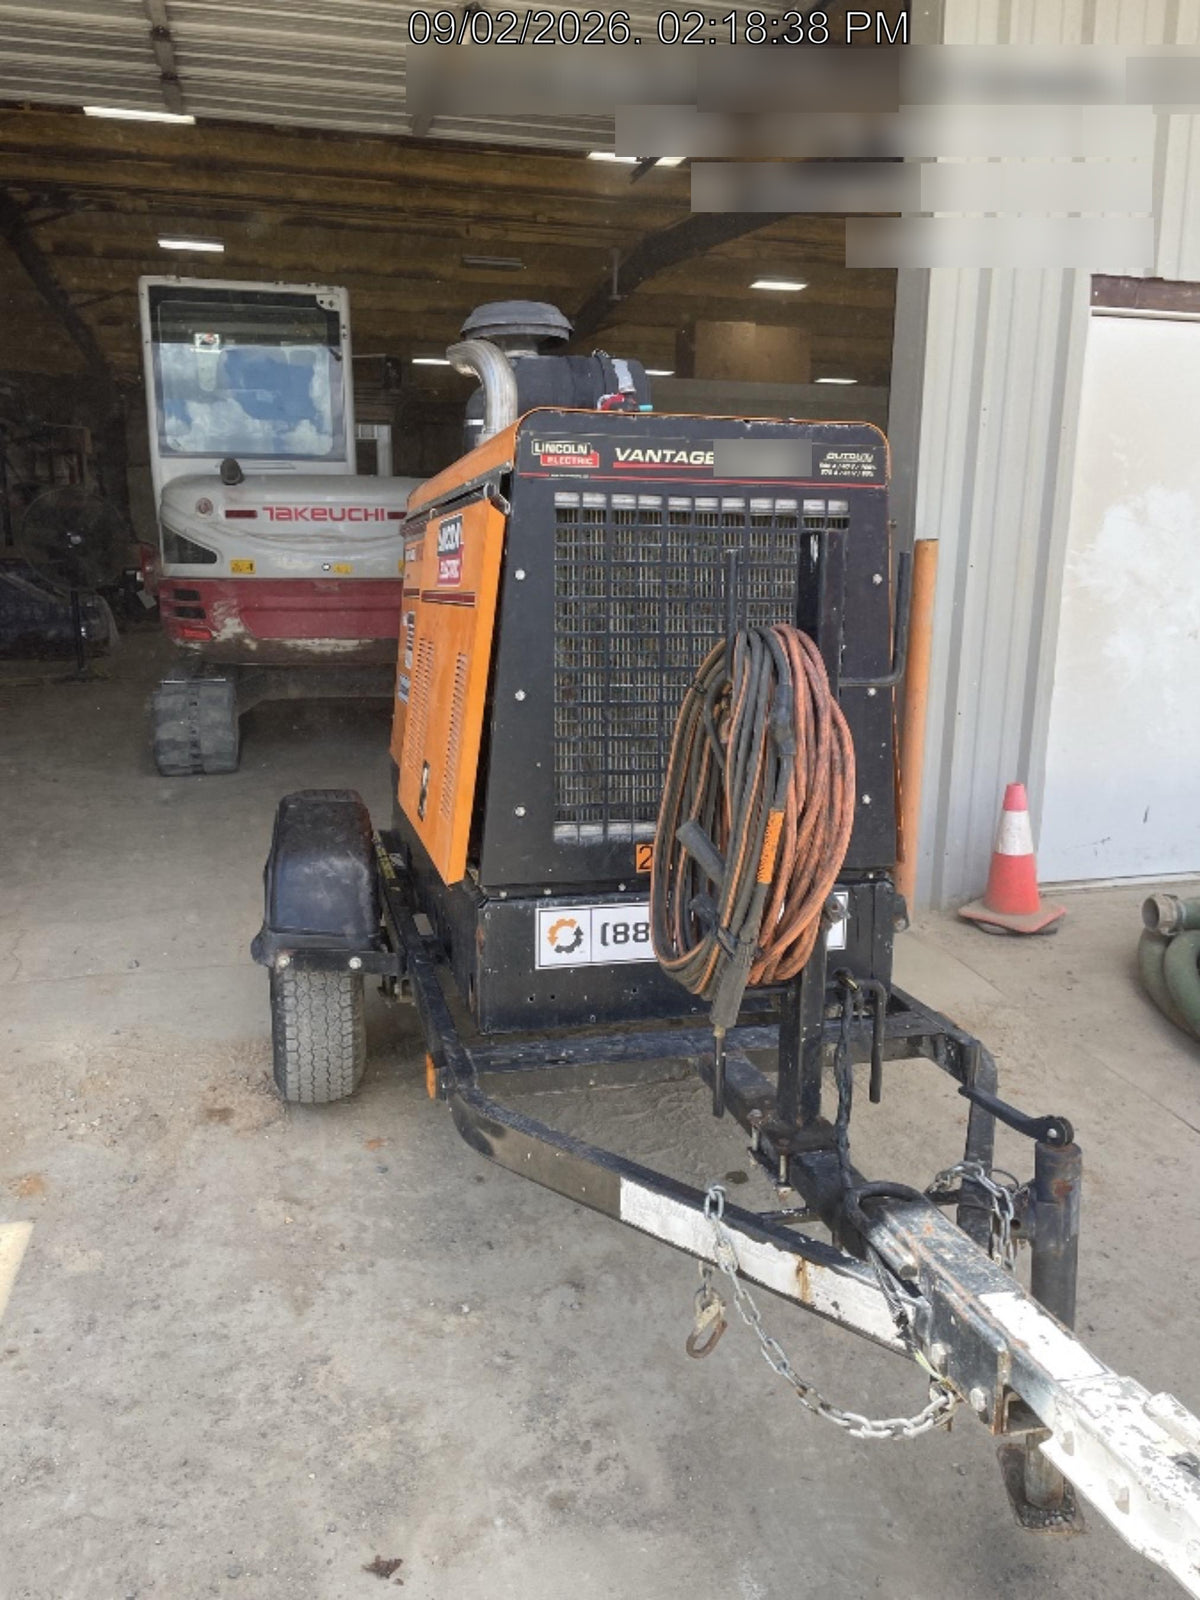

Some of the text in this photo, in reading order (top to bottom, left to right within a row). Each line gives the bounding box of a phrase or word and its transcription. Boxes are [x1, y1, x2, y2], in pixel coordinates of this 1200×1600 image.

[534, 442, 588, 454] LINCOLN
[546, 456, 593, 465] ELECTRIC
[614, 447, 714, 465] VANTAGE
